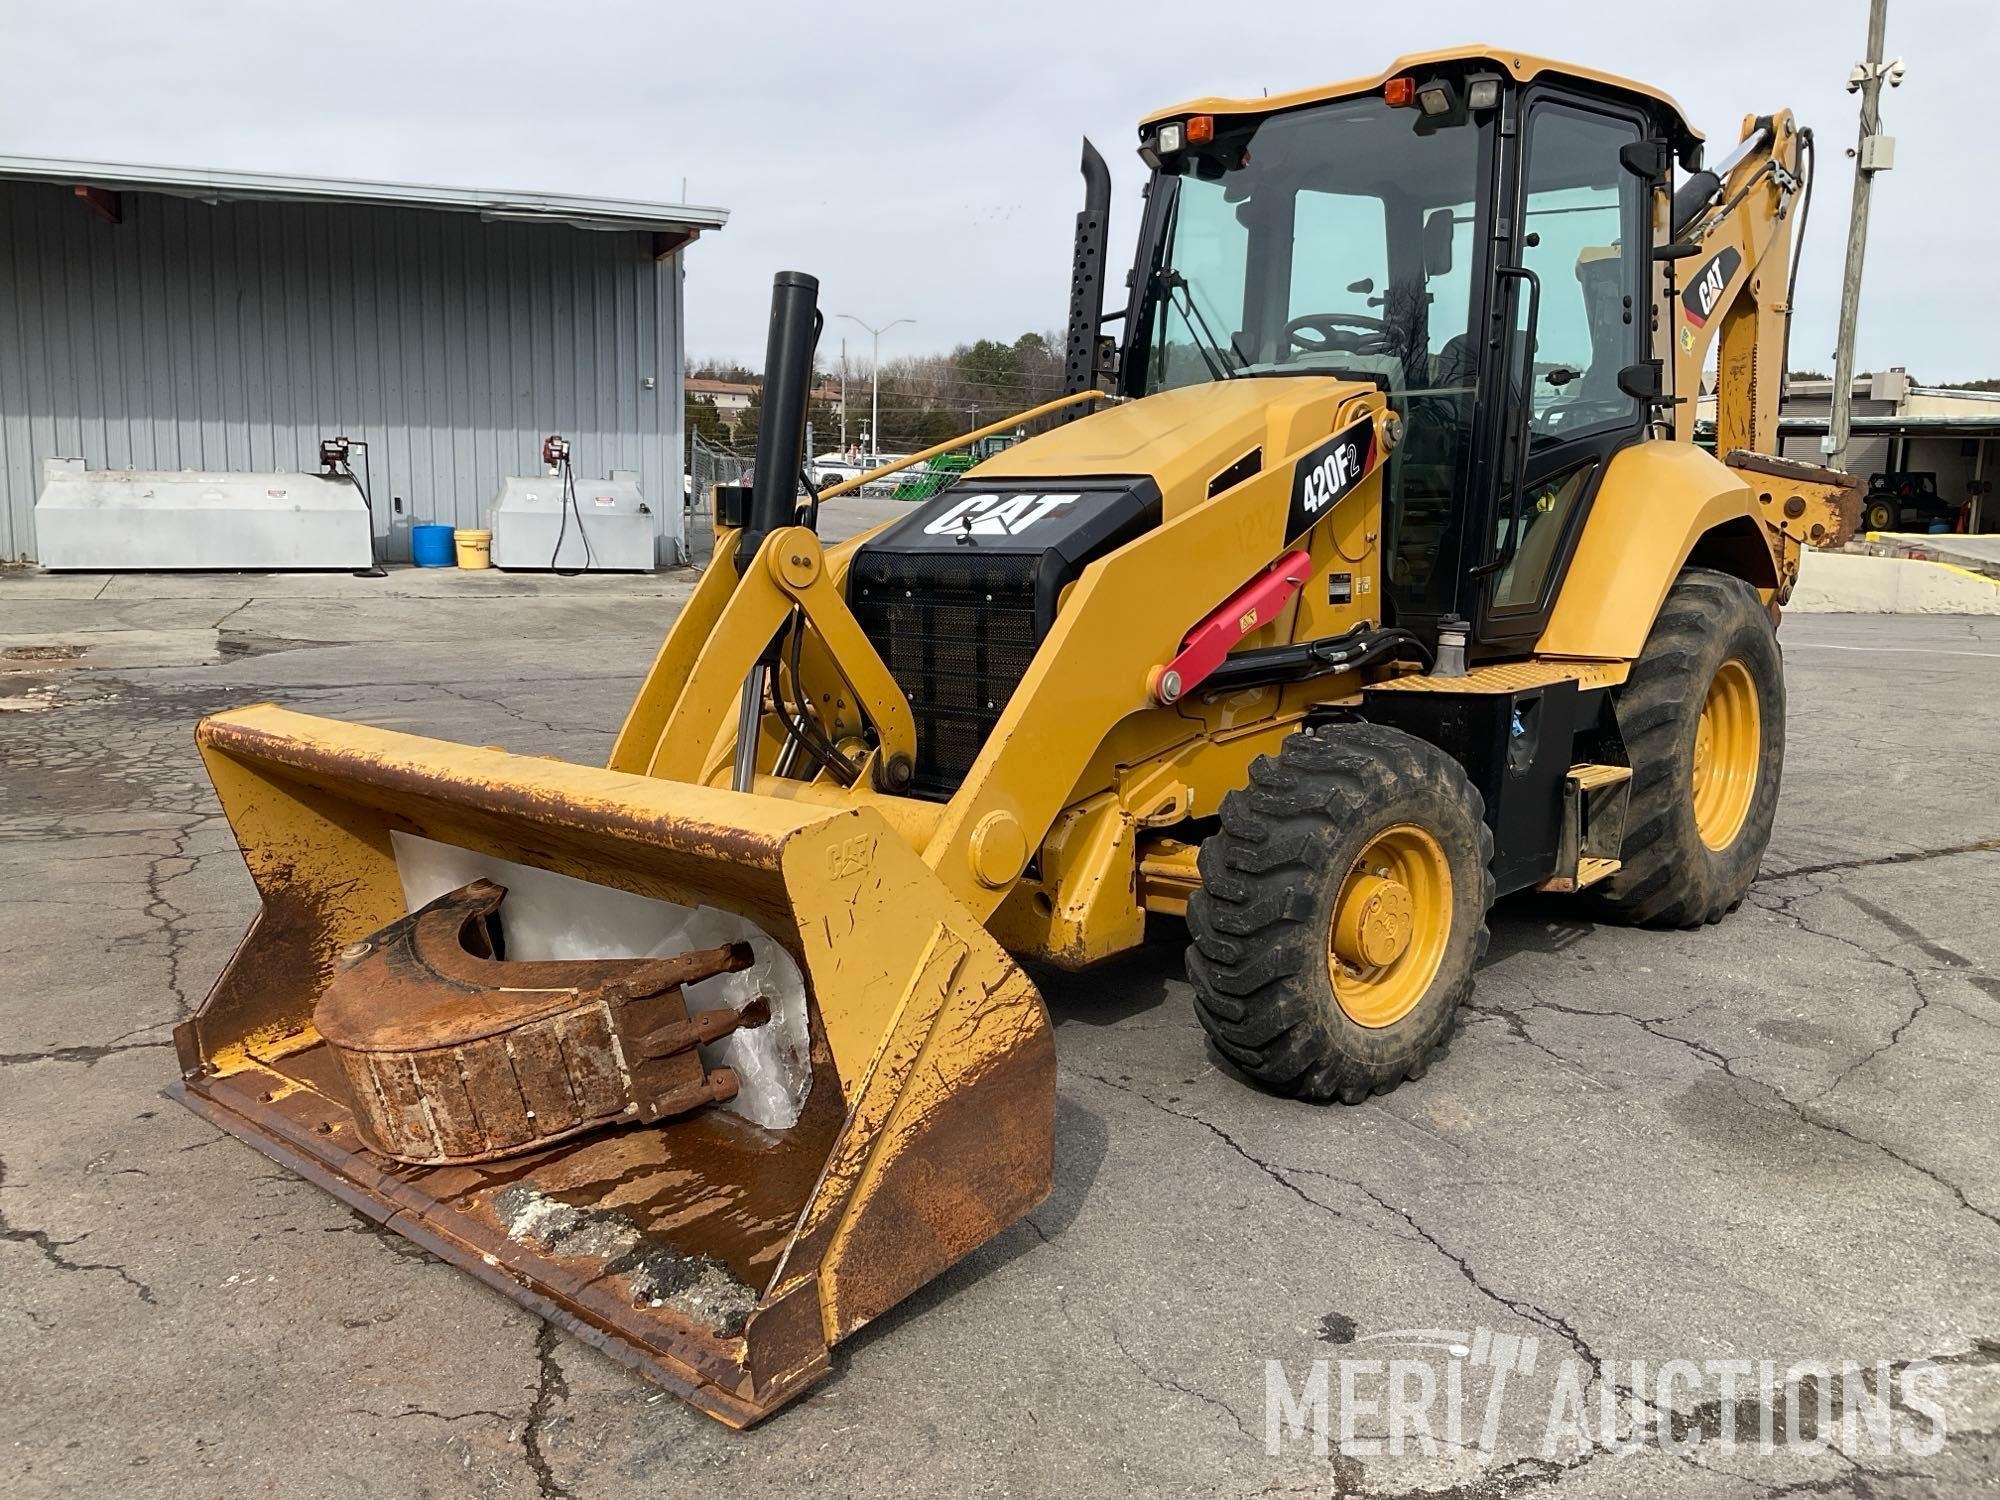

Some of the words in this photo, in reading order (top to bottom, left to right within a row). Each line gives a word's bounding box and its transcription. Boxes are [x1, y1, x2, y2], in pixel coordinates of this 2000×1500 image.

[1699, 256, 1724, 315] CAT
[923, 494, 1081, 536] CAT
[826, 832, 868, 881] CAT
